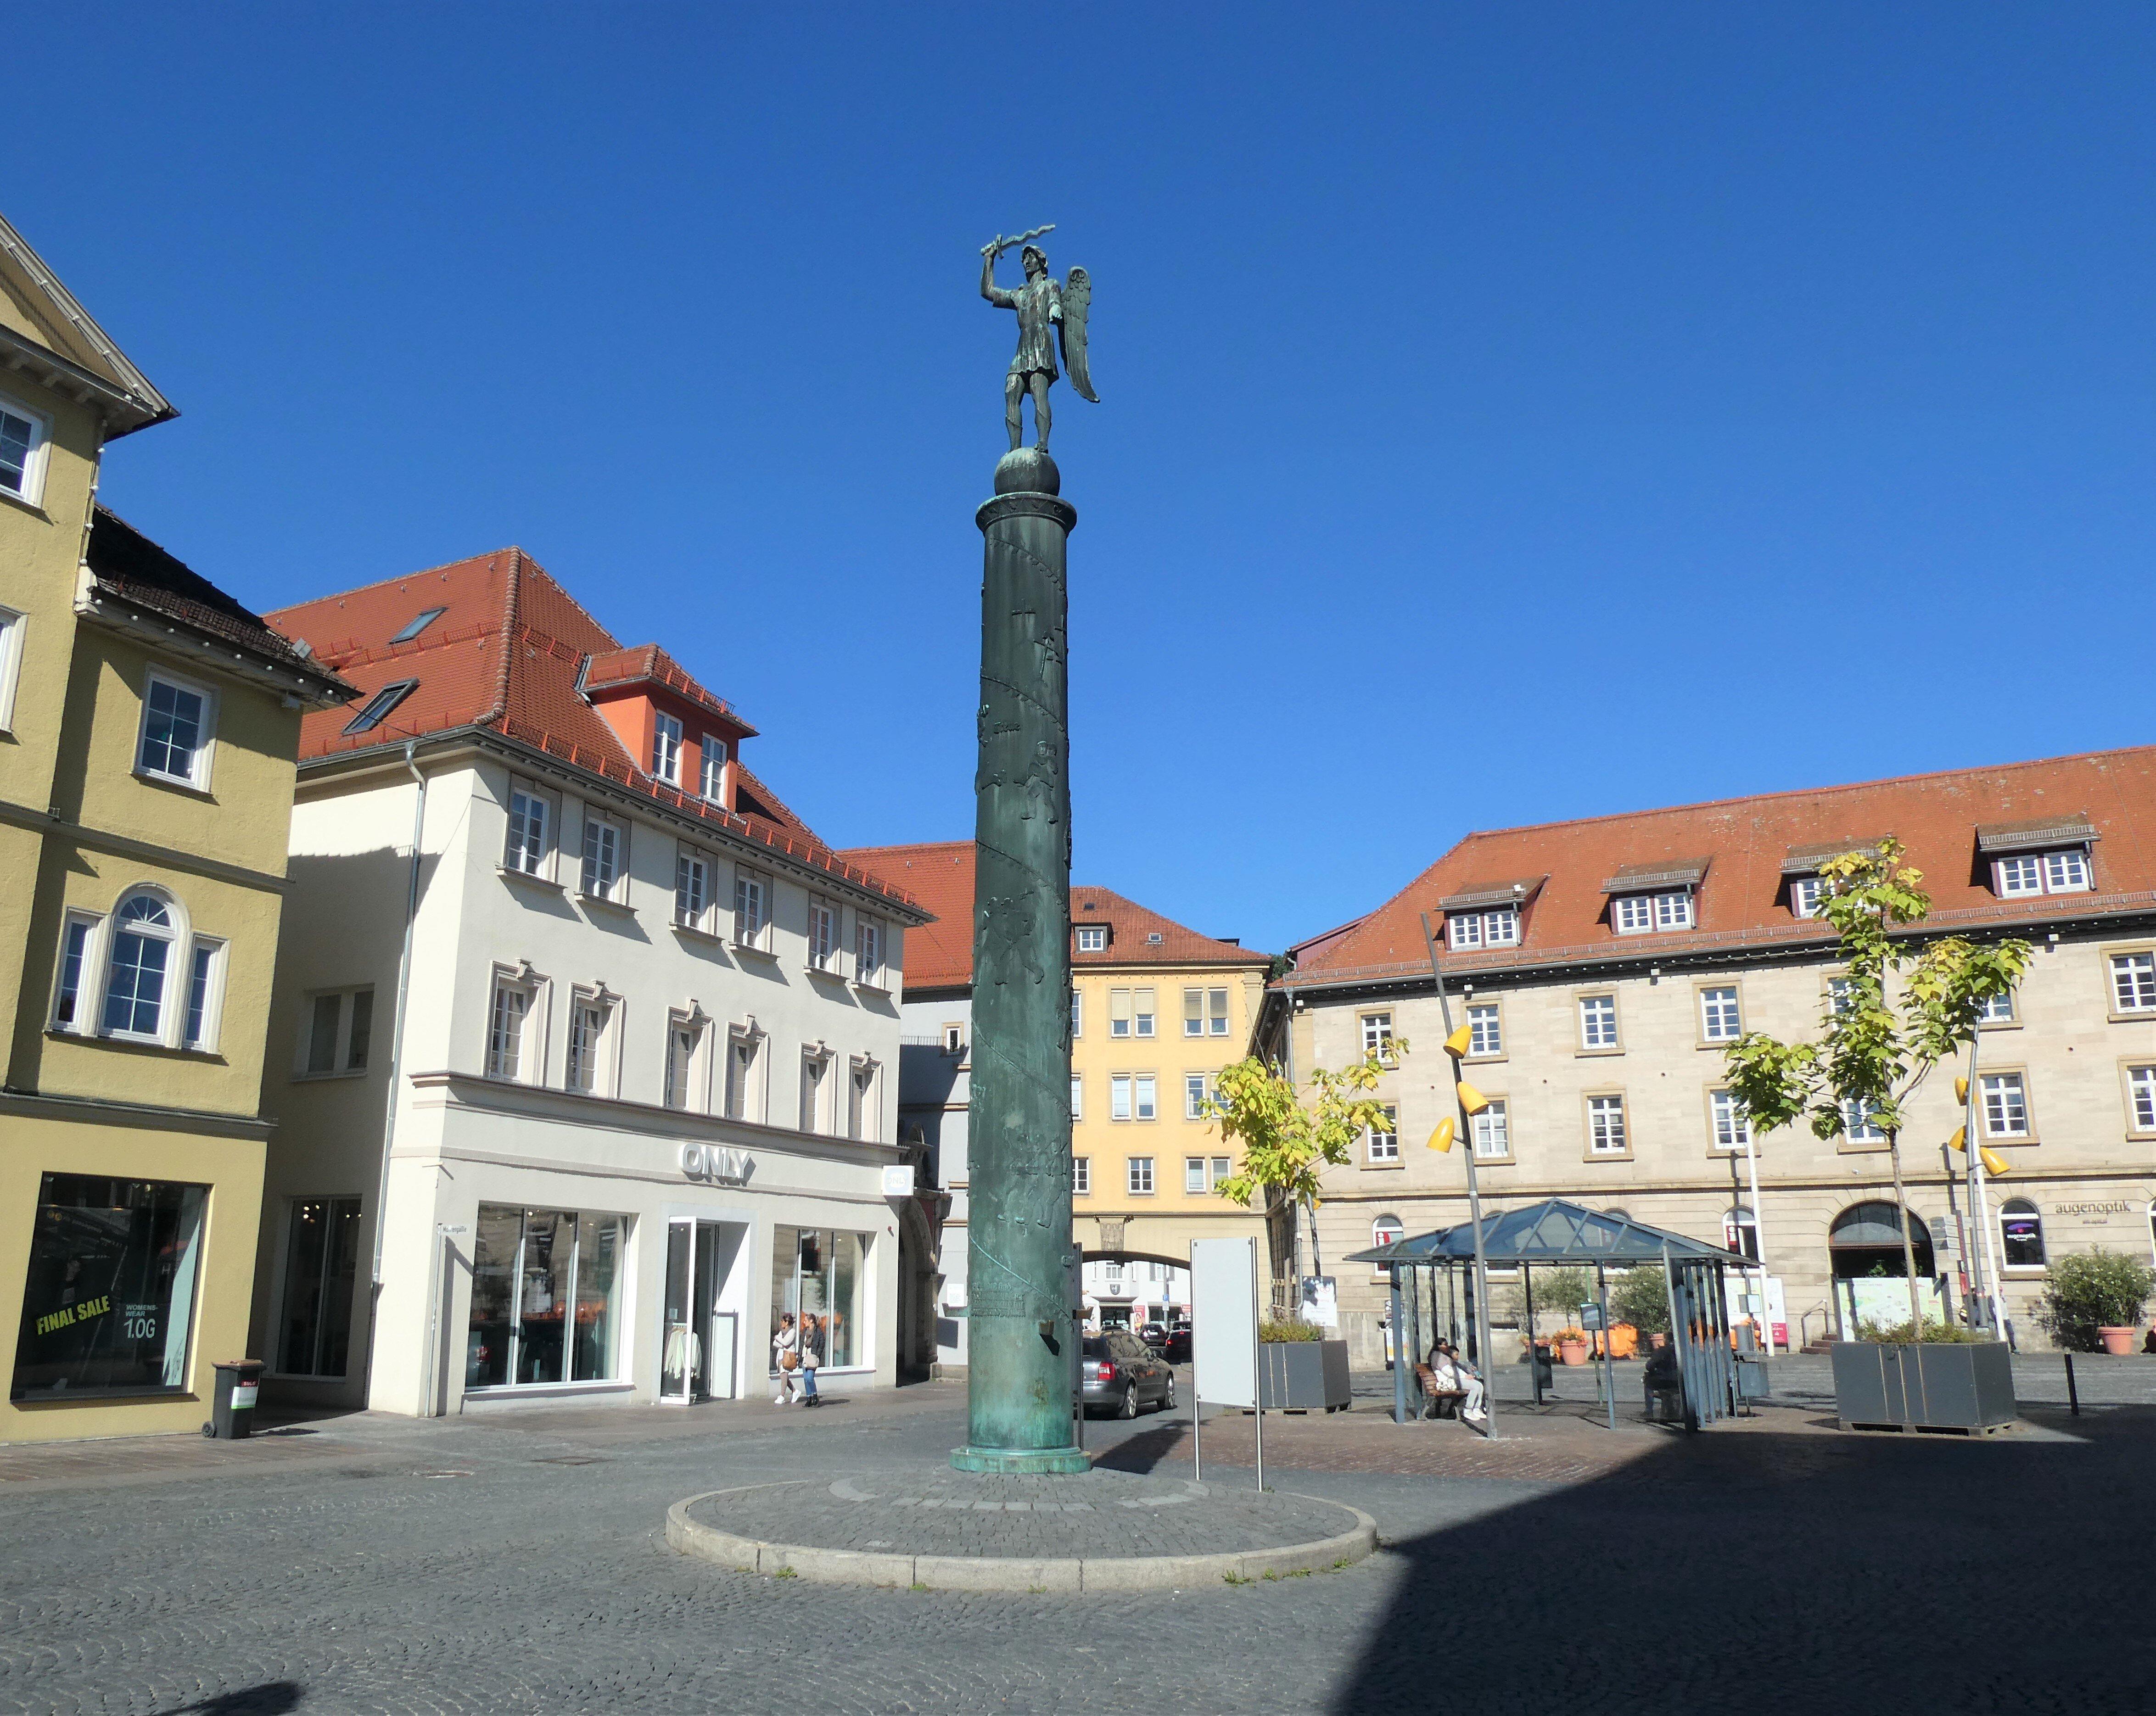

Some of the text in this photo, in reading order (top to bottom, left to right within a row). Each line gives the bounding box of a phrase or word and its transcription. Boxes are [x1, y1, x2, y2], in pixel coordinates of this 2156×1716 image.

[678, 1143, 751, 1178] ONLY
[2055, 1200, 2131, 1216] augenoptik
[36, 1295, 110, 1335] FINAL SALE
